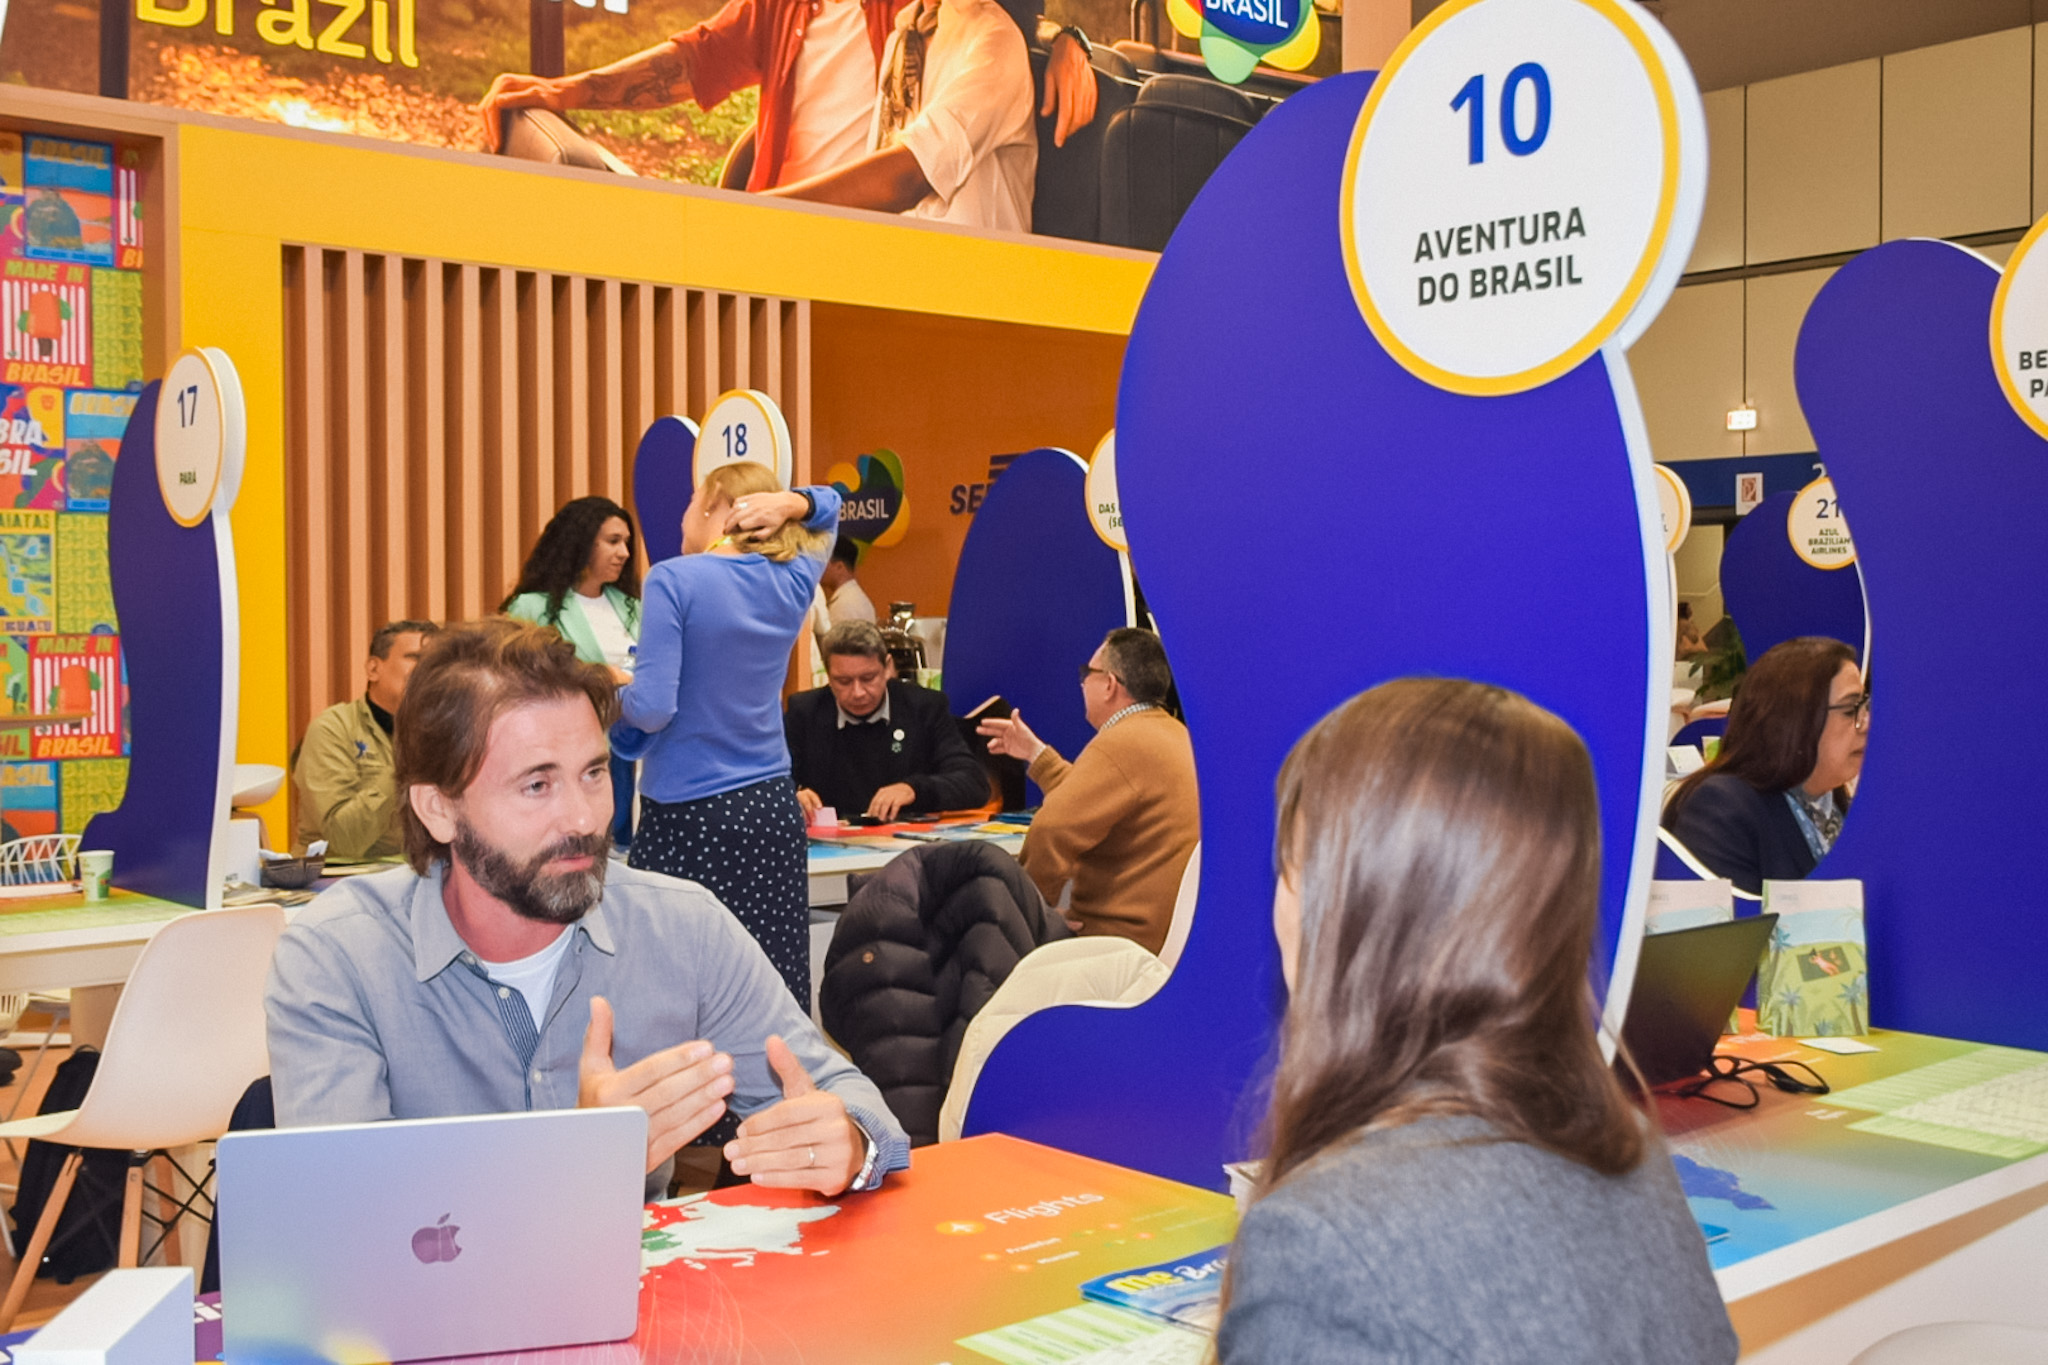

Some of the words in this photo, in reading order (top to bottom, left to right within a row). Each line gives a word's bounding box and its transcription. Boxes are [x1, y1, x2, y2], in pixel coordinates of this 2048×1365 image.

[1450, 62, 1551, 165] 10
[1414, 207, 1586, 263] AVENTURA
[5, 260, 59, 280] MADE
[67, 266, 84, 282] IN
[1418, 273, 1459, 306] DO
[1470, 255, 1583, 299] BRASIL
[6, 362, 85, 386] BRASIL
[2030, 378, 2048, 398] P
[177, 385, 197, 428] 17
[722, 423, 747, 457] 18
[1098, 503, 1116, 513] DAS
[1816, 498, 1840, 519] 21
[1818, 529, 1840, 537] AZUL
[1811, 547, 1848, 555] AIRLINES
[36, 637, 88, 654] MADE
[96, 638, 113, 653] IN
[37, 736, 115, 758] BRASIL
[984, 1193, 1105, 1224] Flights
